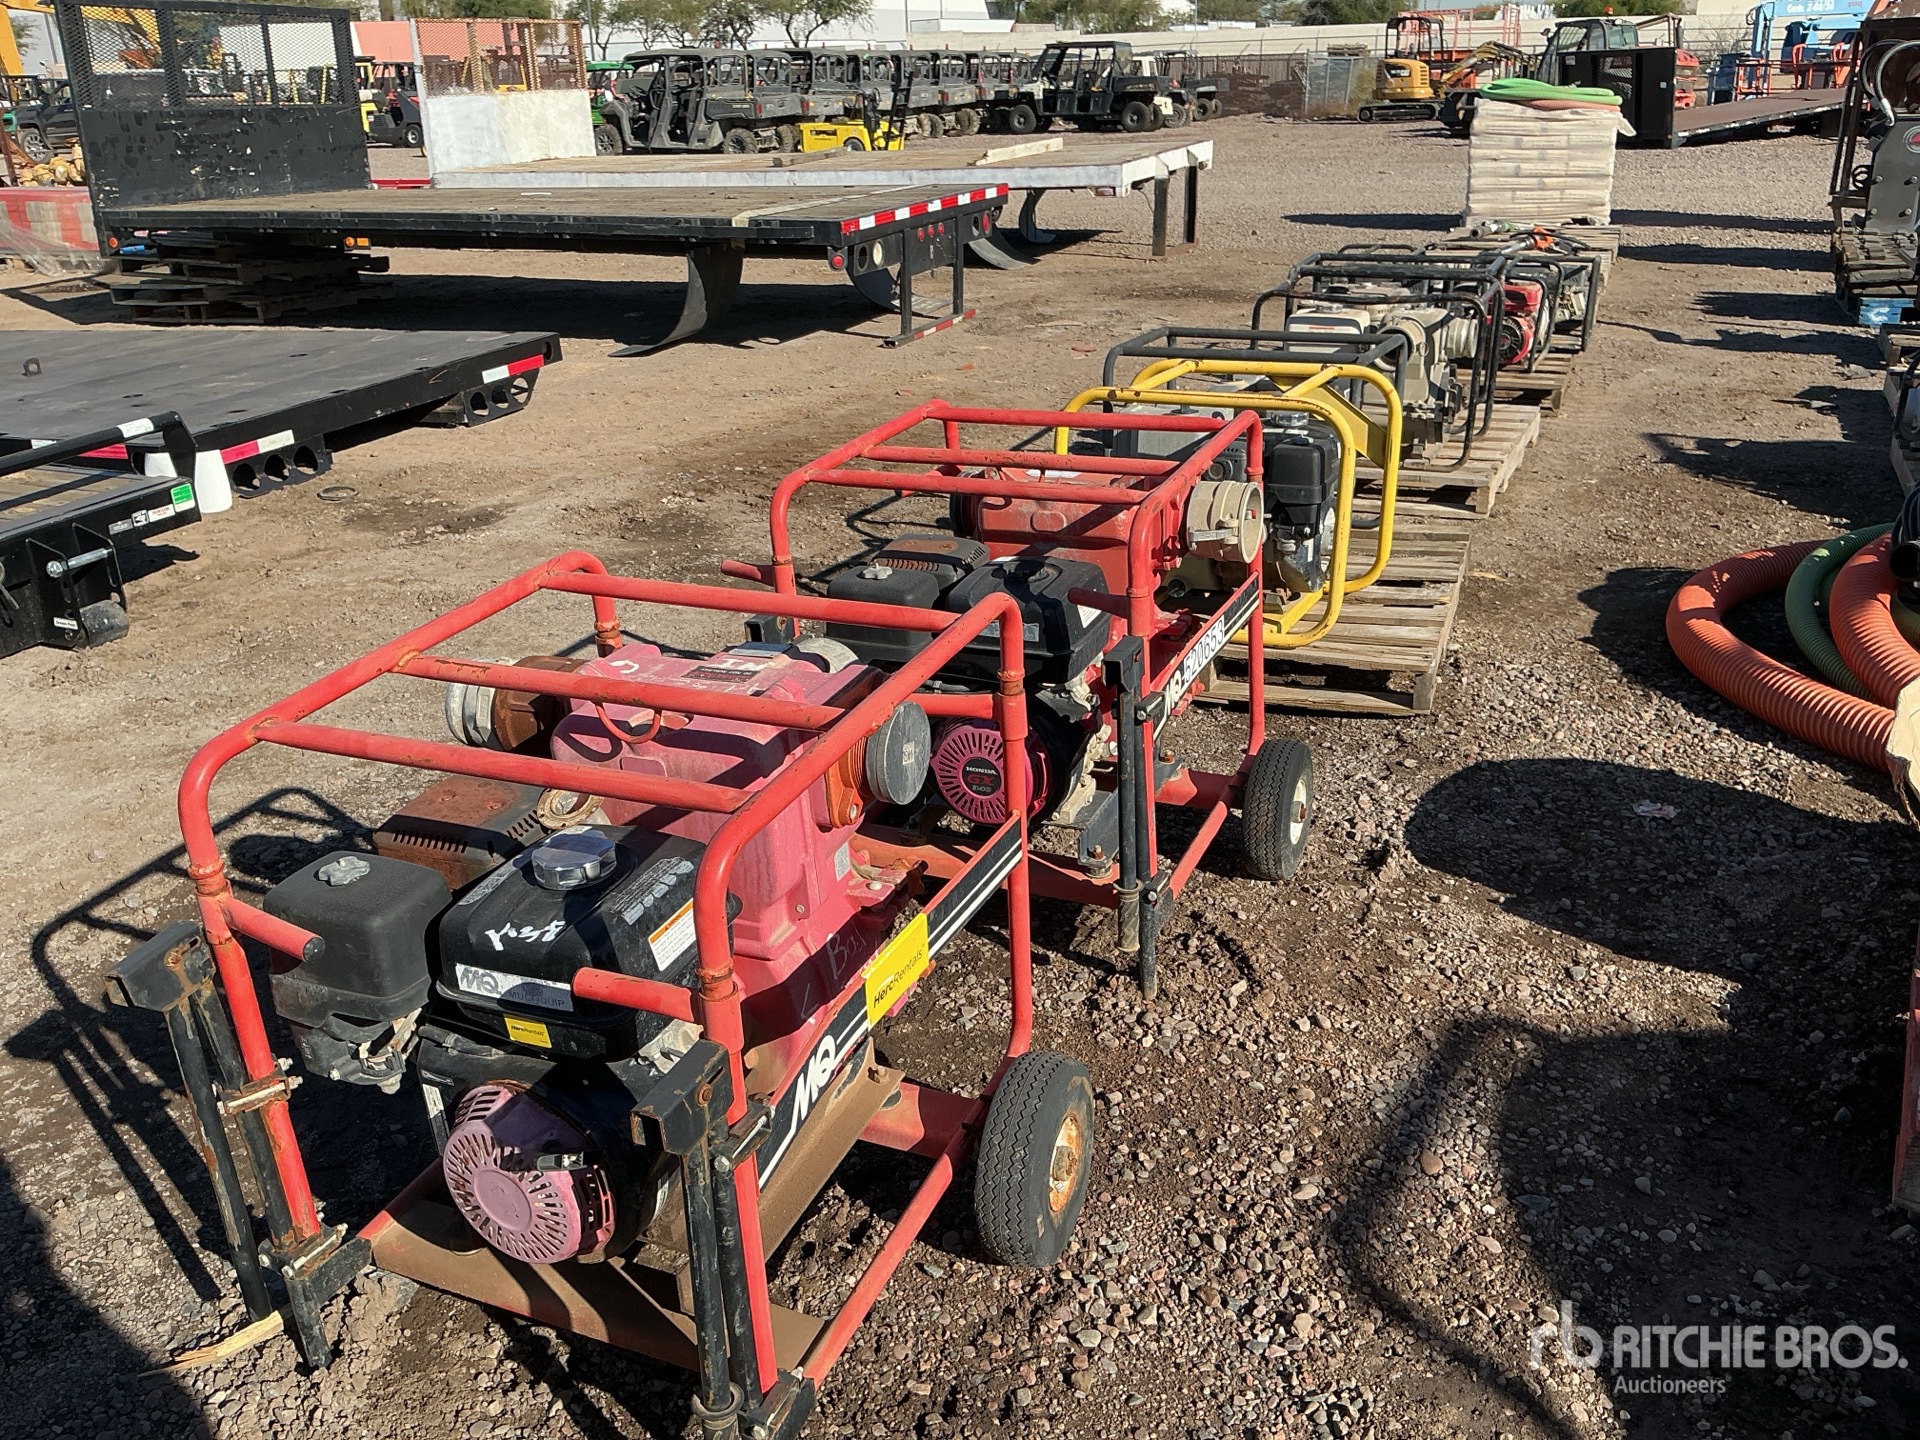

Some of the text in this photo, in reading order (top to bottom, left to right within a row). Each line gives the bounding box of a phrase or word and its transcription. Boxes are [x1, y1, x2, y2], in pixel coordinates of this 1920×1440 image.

[1183, 619, 1224, 683] 520653
[965, 766, 998, 775] HONDA
[967, 774, 995, 786] GX
[459, 967, 565, 1008] MQ MULTIQUIP
[788, 1034, 837, 1120] MQ
